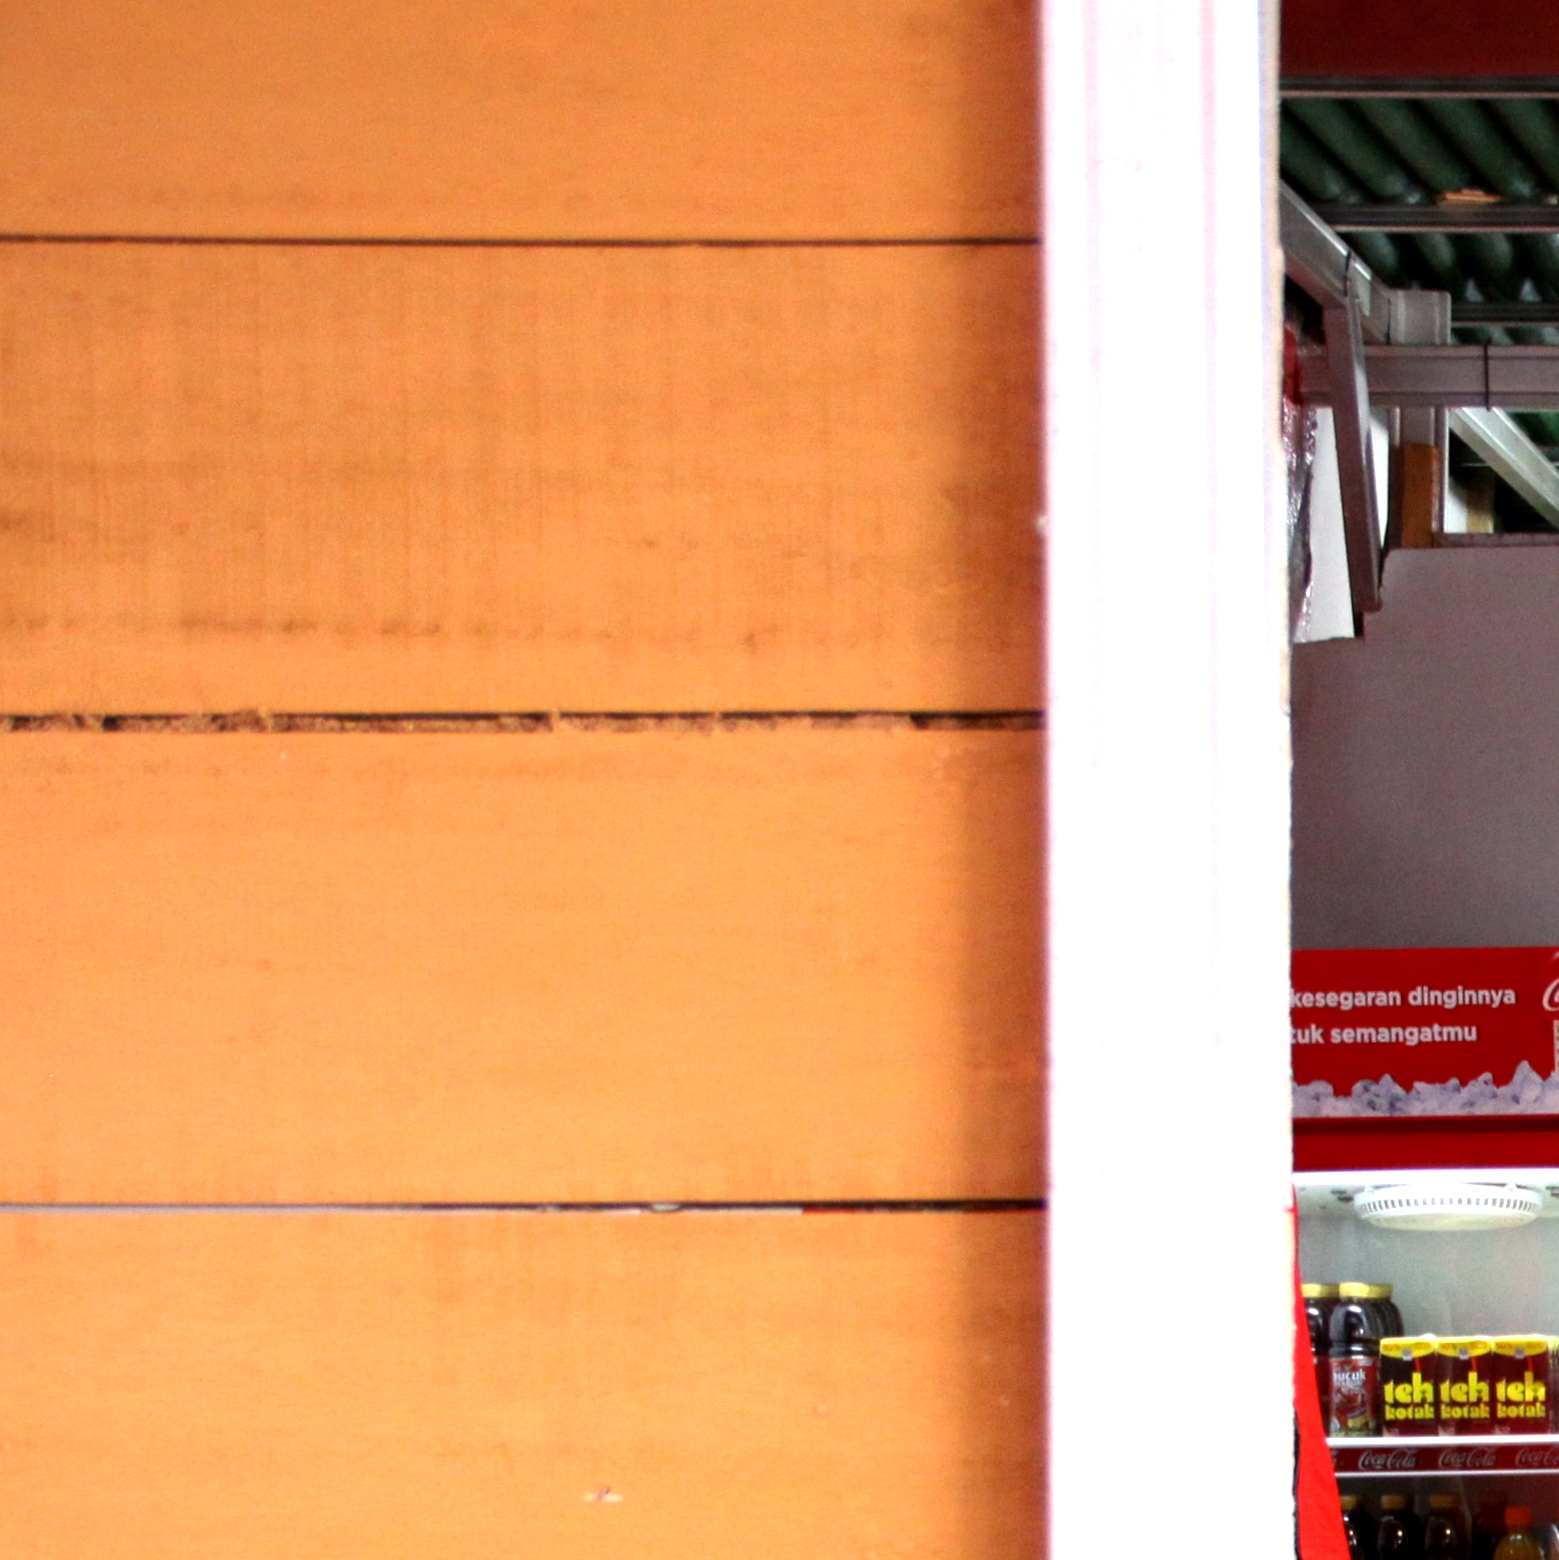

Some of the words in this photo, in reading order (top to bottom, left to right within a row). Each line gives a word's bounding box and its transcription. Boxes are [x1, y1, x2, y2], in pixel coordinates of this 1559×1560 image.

[1289, 988, 1402, 1011] kesegaran
[1408, 986, 1516, 1009] dinginnya
[1330, 1023, 1477, 1046] semangatmu
[1384, 1372, 1434, 1404] teh
[1439, 1371, 1490, 1403] teh
[1495, 1371, 1546, 1403] teh
[1385, 1403, 1435, 1421] kotak
[1440, 1402, 1490, 1419] kotak
[1497, 1402, 1546, 1418] kotak
